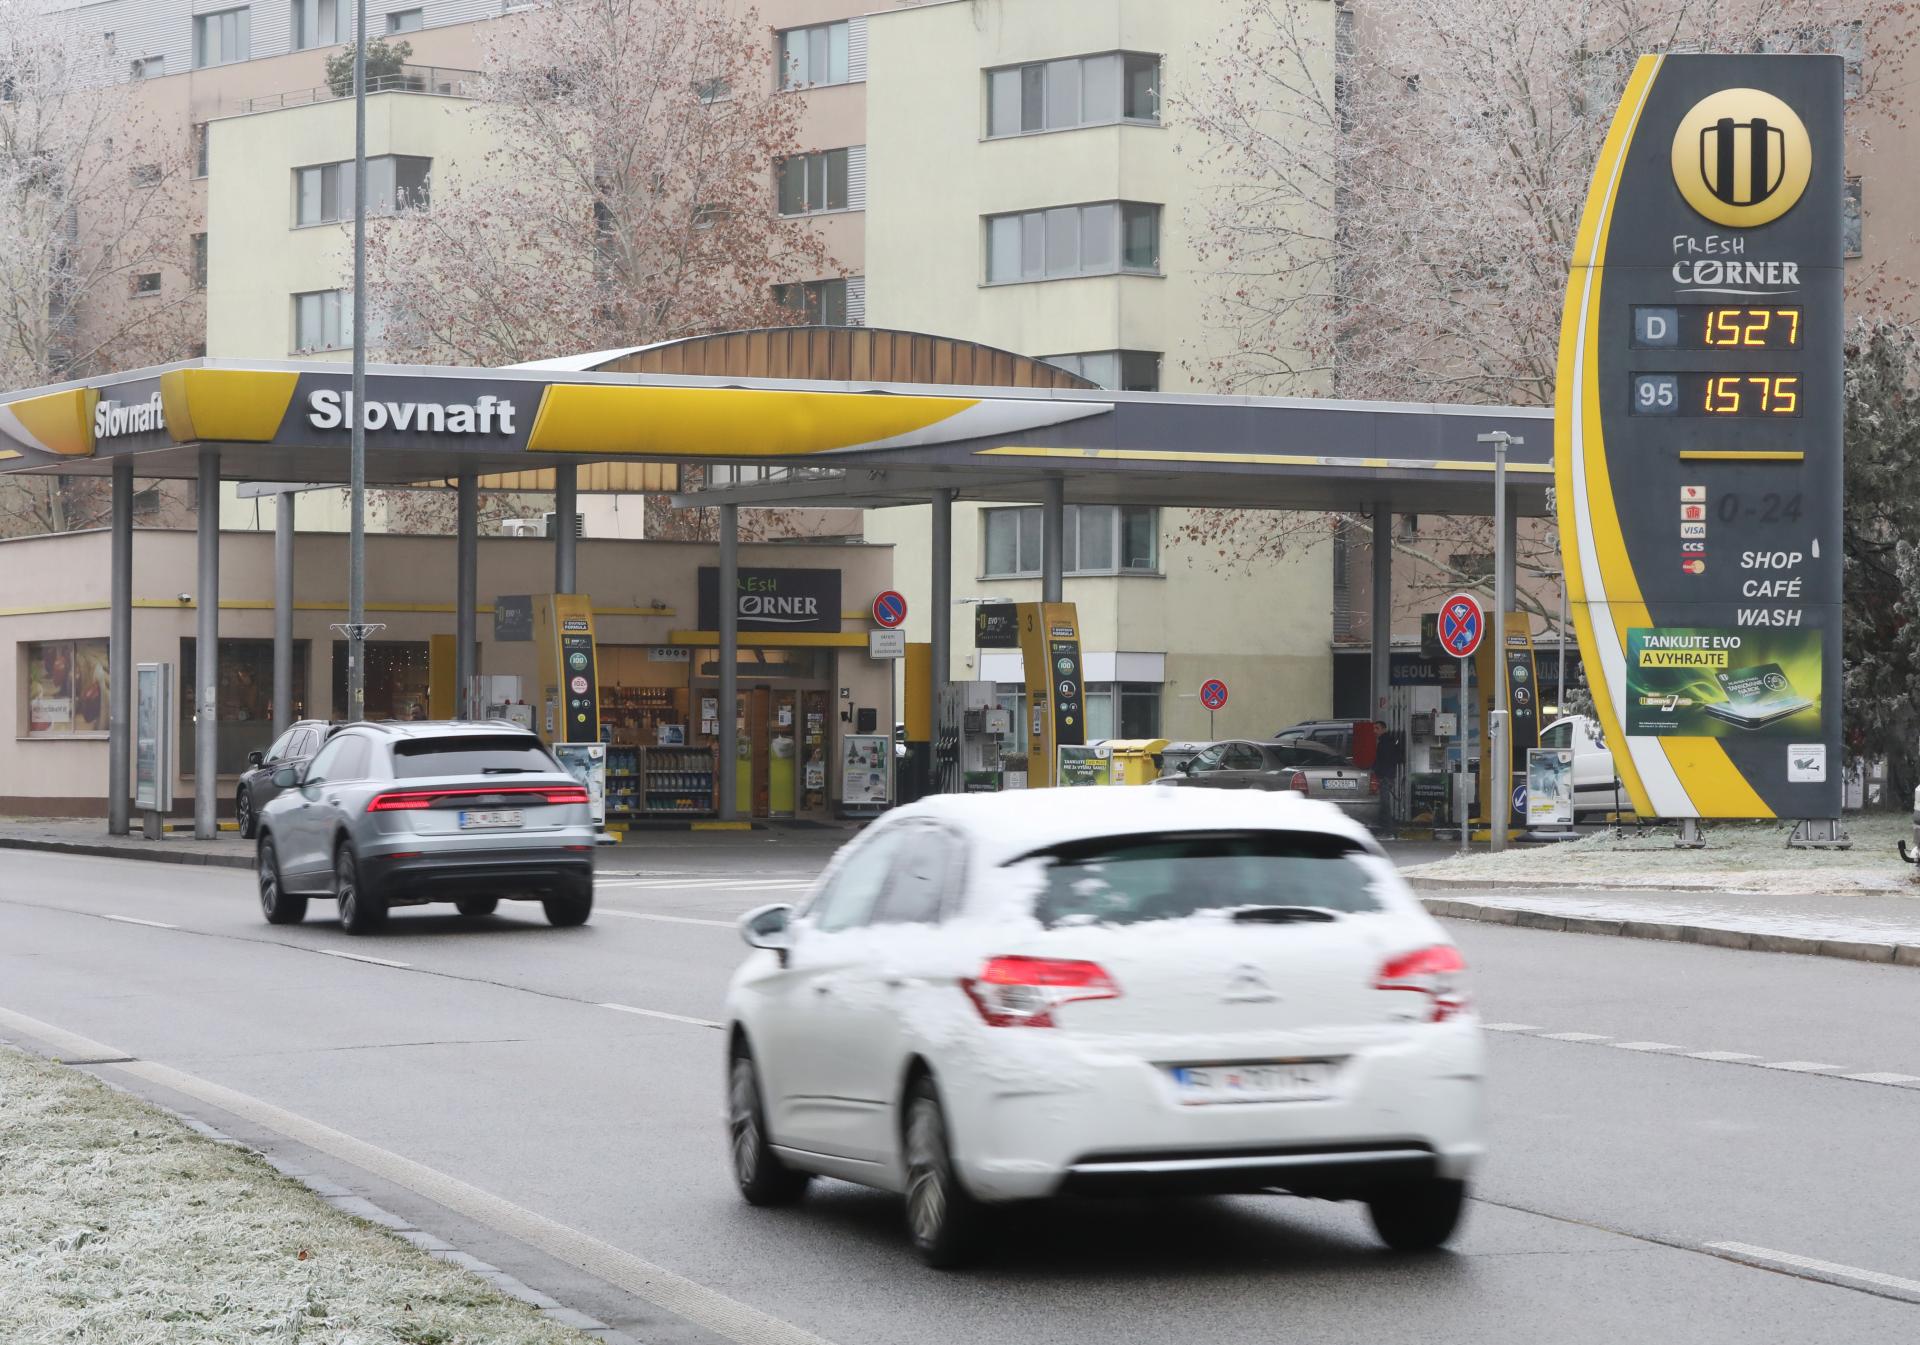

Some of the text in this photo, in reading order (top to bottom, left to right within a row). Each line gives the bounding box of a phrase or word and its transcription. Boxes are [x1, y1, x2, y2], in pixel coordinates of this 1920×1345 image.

[1672, 234, 1745, 255] FRESH
[1646, 316, 1667, 340] D
[1639, 382, 1673, 406] 95
[94, 391, 166, 438] Slovnaft
[307, 389, 516, 434] Slovnaft
[1684, 526, 1705, 535] VISA
[1740, 551, 1803, 569] SHOP
[737, 577, 777, 593] RESH
[1742, 576, 1802, 598] CAFÉ
[738, 595, 819, 615] ORNER
[1027, 614, 1034, 633] 3
[1737, 608, 1802, 627] WASH
[1642, 635, 1741, 649] TANKUJTE EVO
[1642, 652, 1725, 666] A VYHRAJTE
[1392, 664, 1436, 678] SEOUL
